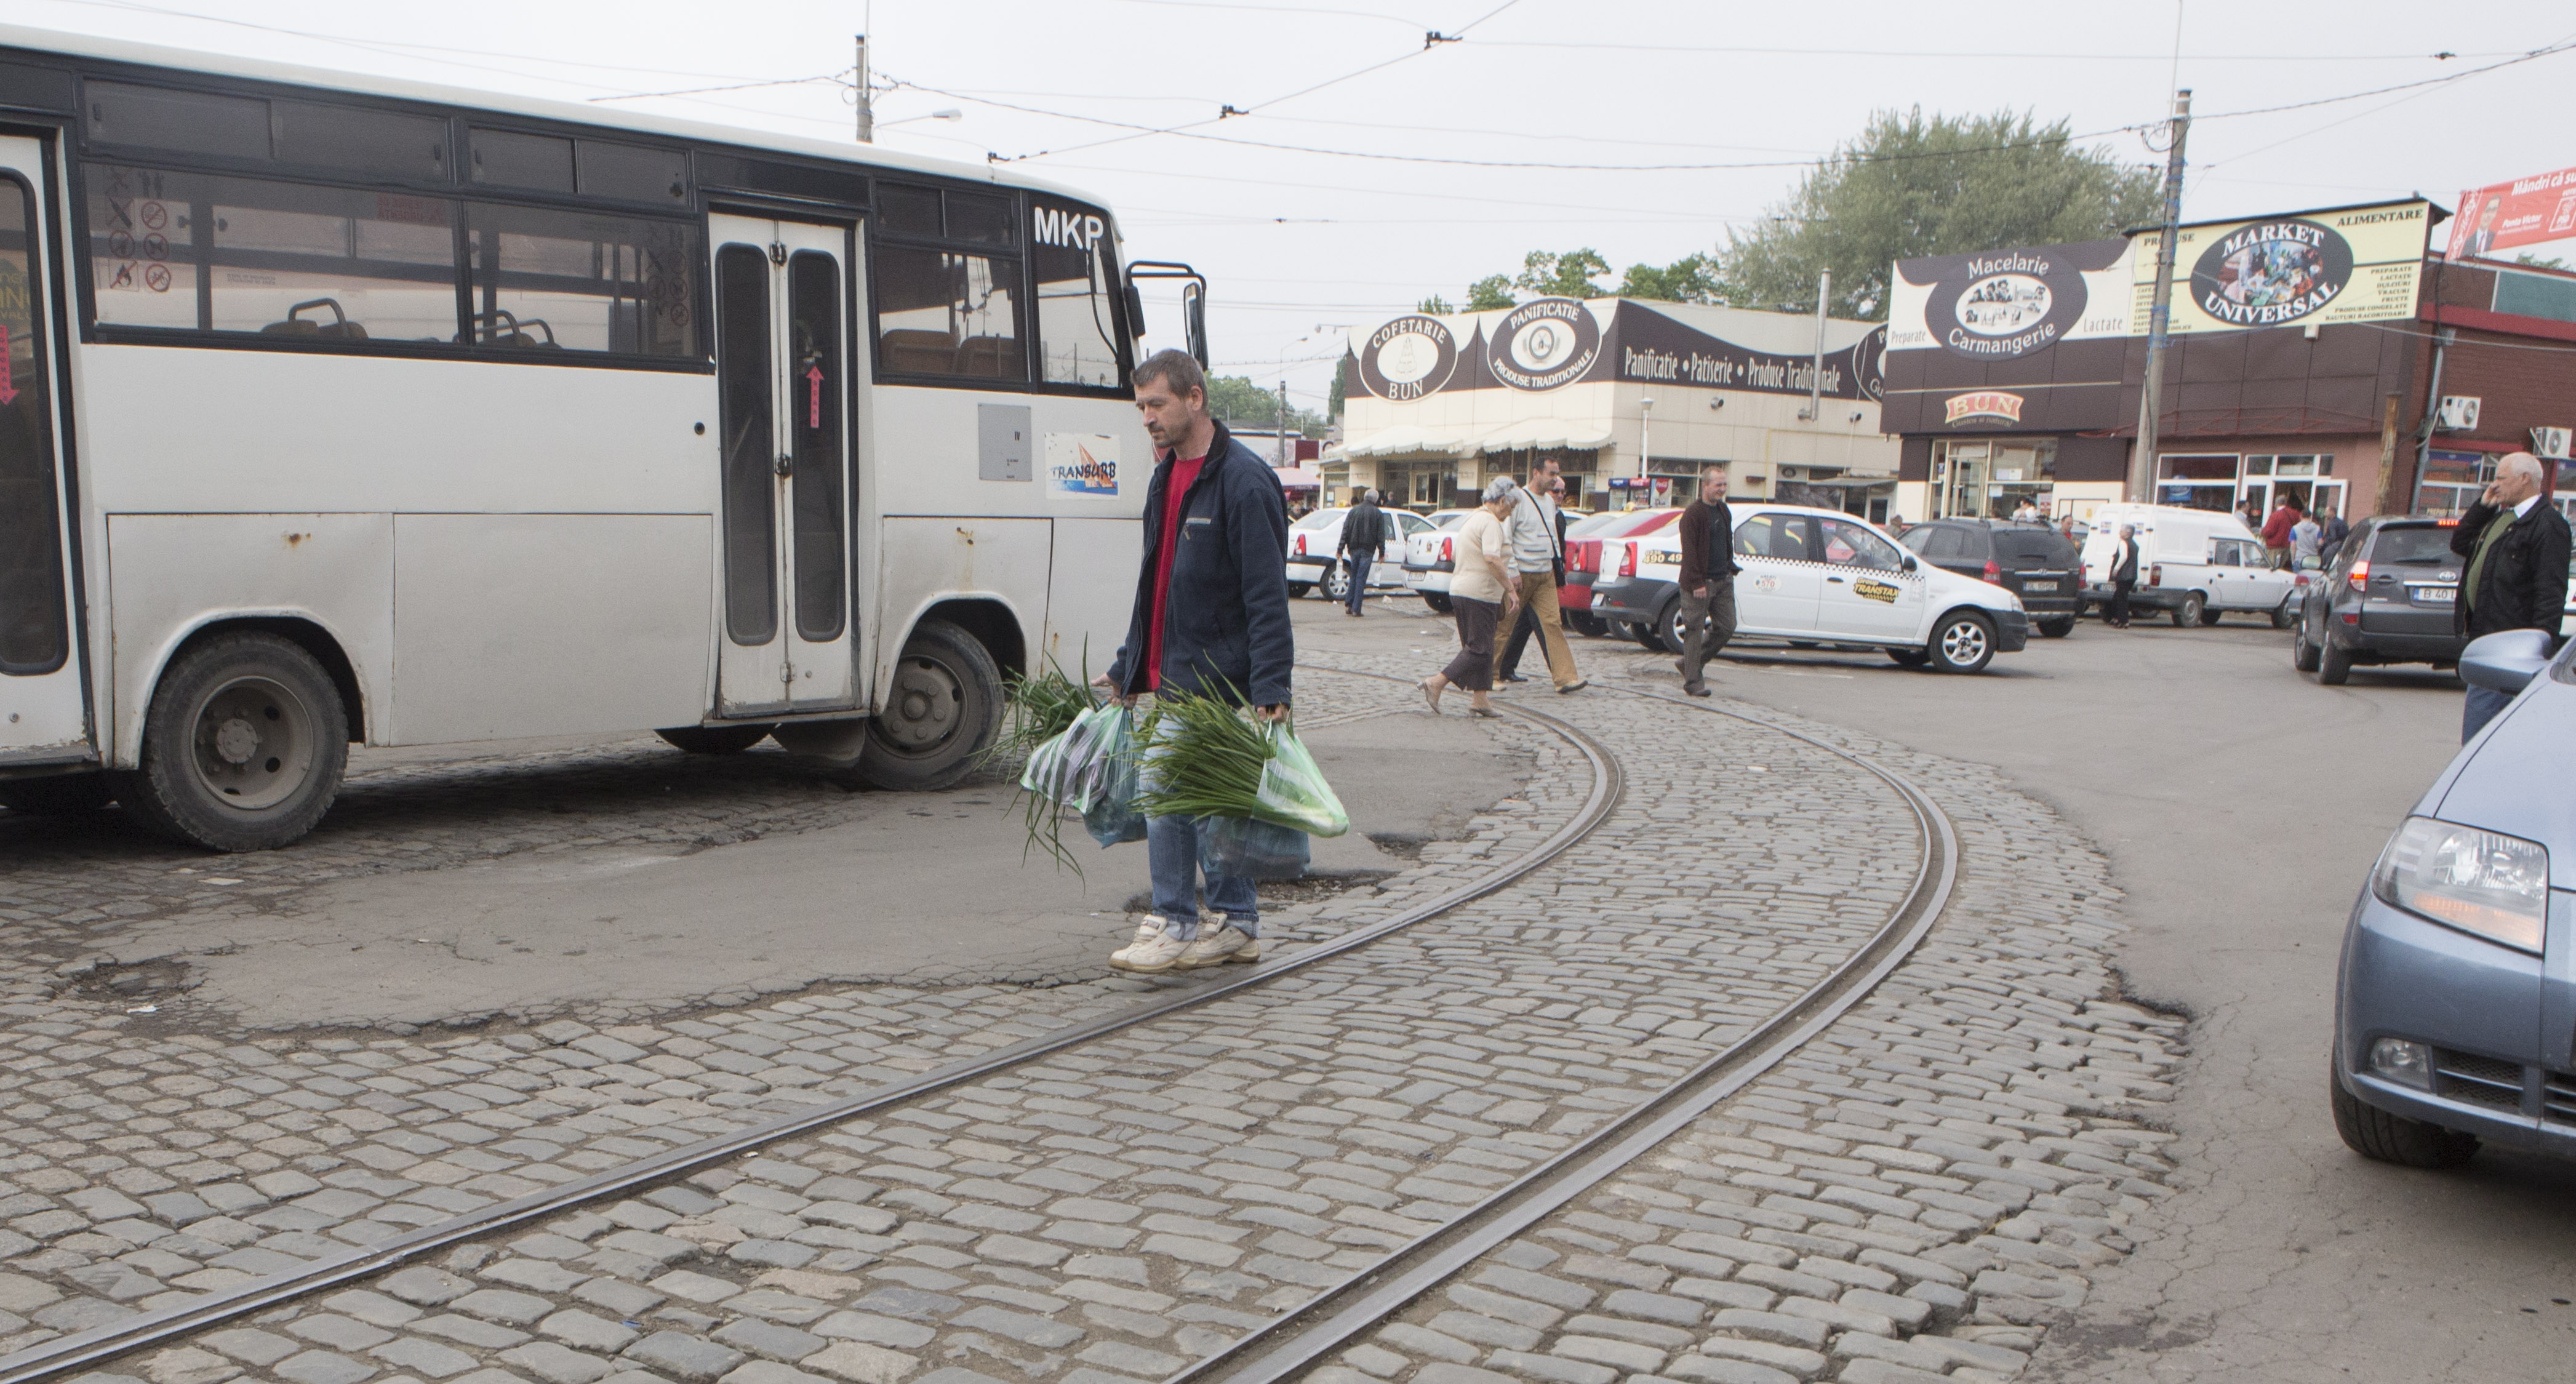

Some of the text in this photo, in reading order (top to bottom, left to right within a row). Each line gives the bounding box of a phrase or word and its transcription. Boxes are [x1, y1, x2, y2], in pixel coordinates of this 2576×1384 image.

[2511, 174, 2551, 196] Mândri
[2551, 171, 2564, 188] că
[2564, 172, 2576, 185] su
[2337, 209, 2423, 227] ALIMENTARE
[1034, 207, 1104, 251] MKP
[2144, 233, 2195, 246] PRUSE
[2222, 223, 2325, 258] MARKET
[1969, 252, 2050, 279] Macelarie
[2371, 266, 2412, 274] PREPARATE
[2204, 281, 2339, 323] UNIVERSAL
[1510, 302, 1580, 329] PANIFICATIE
[2083, 317, 2123, 333] Lactate
[1373, 319, 1447, 349] COFETARIE
[1891, 328, 1926, 346] Preparate
[1948, 322, 2056, 355] Carmangerie
[1494, 349, 1593, 388] PRODUSE TRADITIONALE
[1625, 346, 1840, 393] Panificatie Patiserie Produse Traditnale
[1388, 380, 1424, 400] BUN
[1953, 396, 2014, 415] BUN
[1050, 460, 1116, 480] TRANSURB
[1642, 553, 1682, 564] 490 49
[1854, 583, 1900, 598] TRANSTAX
[1857, 576, 1879, 586] Group
[2423, 588, 2431, 599] B
[2435, 588, 2448, 599] 40
